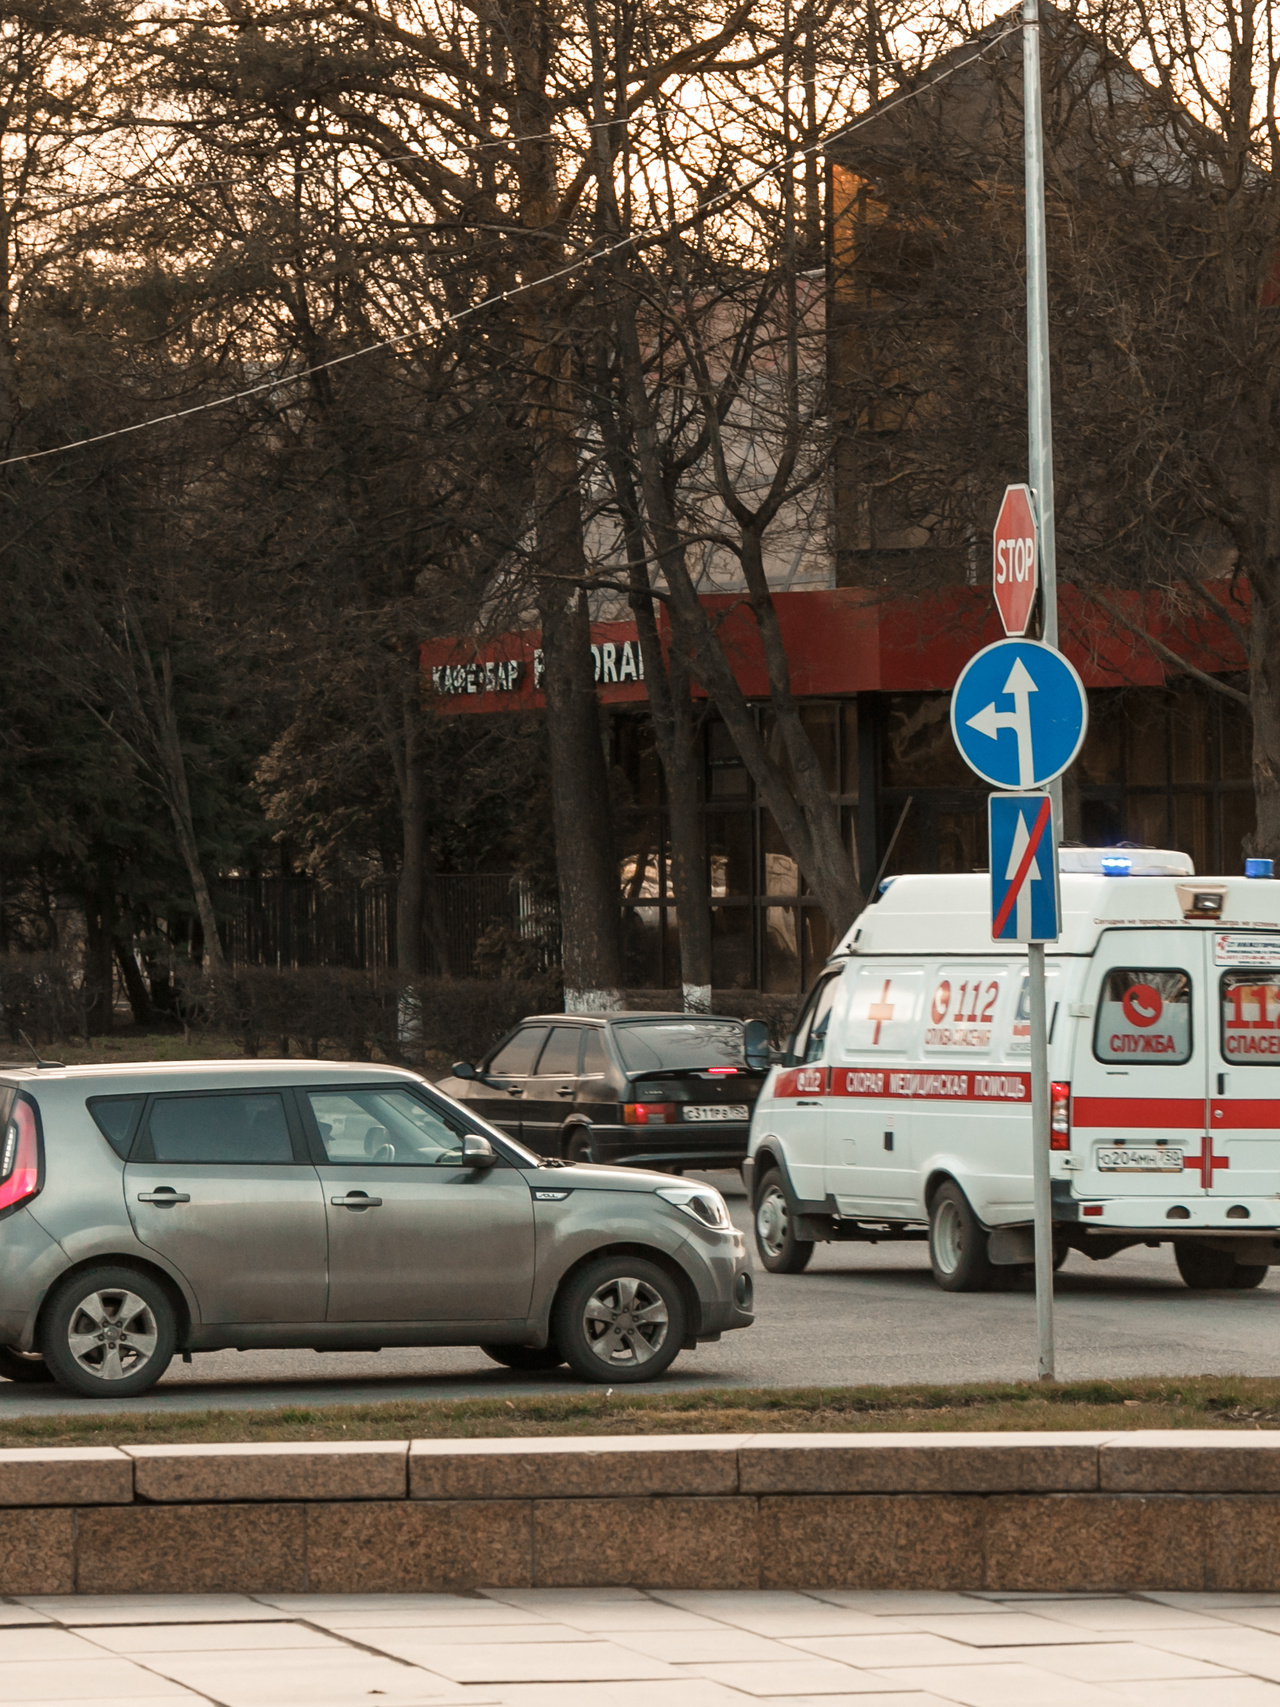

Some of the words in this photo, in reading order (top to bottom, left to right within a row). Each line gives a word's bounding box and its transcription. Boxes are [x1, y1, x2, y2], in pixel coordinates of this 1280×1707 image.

[997, 537, 1034, 584] STOP
[953, 980, 999, 1023] 112
[1109, 1034, 1177, 1054] СЛУЖБА
[845, 1072, 884, 1094] СКОРАЯ
[888, 1073, 969, 1097] МЕДИЦИНСКАЯ
[973, 1075, 1026, 1099] ПОМОЩЬ
